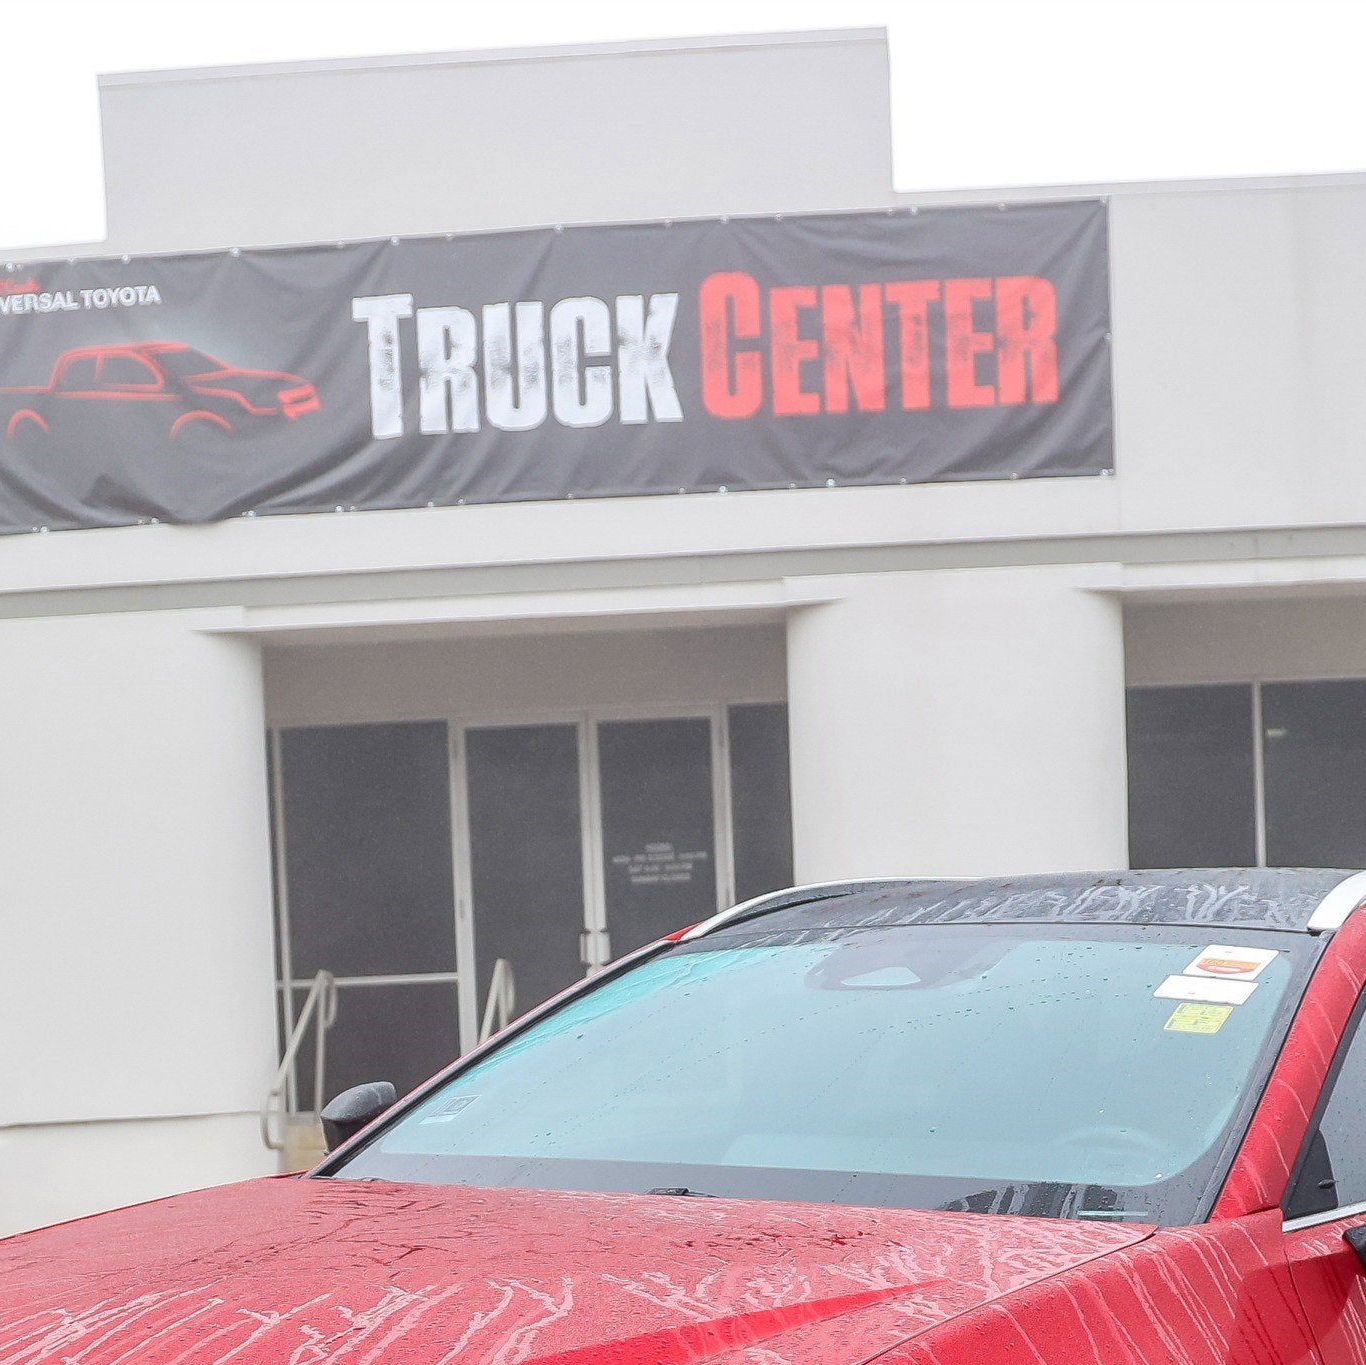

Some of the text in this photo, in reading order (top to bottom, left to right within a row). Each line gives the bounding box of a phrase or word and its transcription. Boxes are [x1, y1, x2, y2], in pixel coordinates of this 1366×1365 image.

[81, 284, 162, 309] TOYOTA
[351, 270, 1060, 440] TRUCK CENTER
